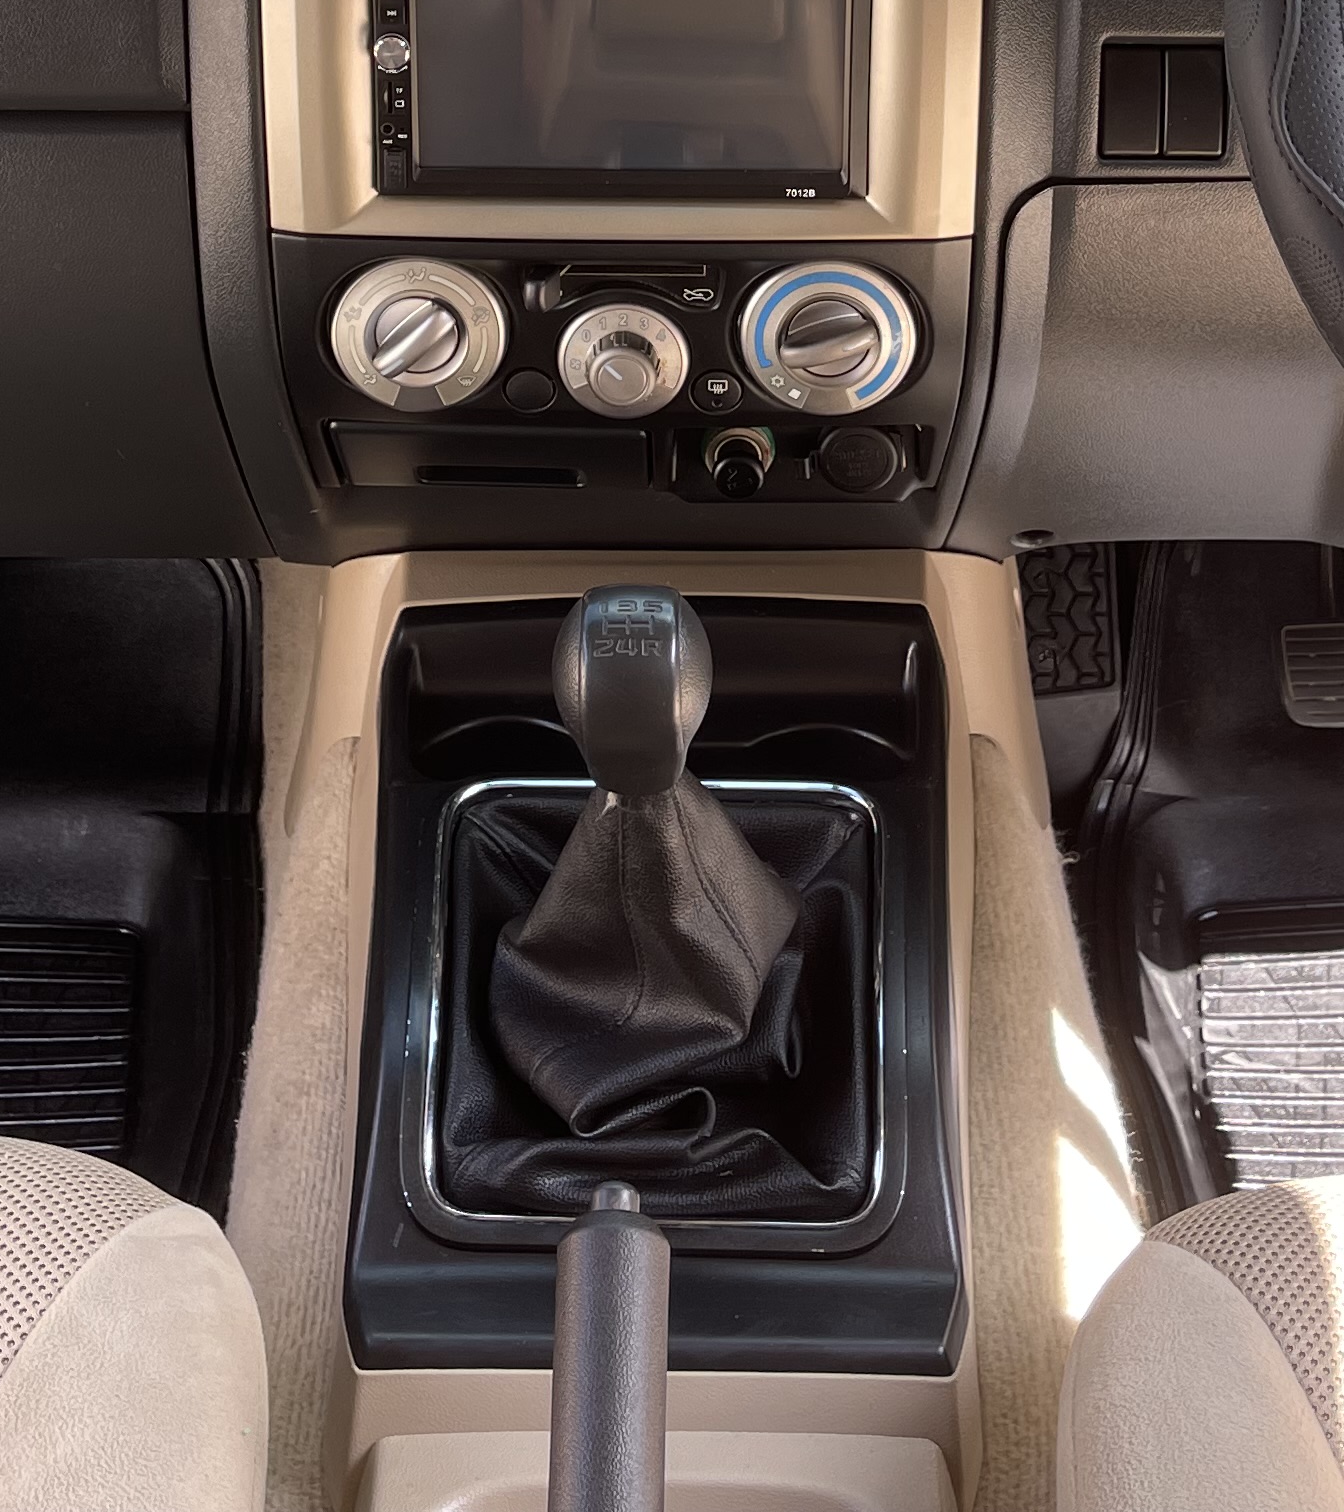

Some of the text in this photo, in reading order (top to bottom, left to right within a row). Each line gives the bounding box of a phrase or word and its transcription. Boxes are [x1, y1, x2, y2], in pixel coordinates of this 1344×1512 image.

[785, 188, 816, 198] 7012B
[599, 317, 607, 329] 1
[618, 313, 628, 326] 2
[640, 318, 649, 330] 3
[581, 329, 591, 342] 0
[656, 329, 666, 342] 4
